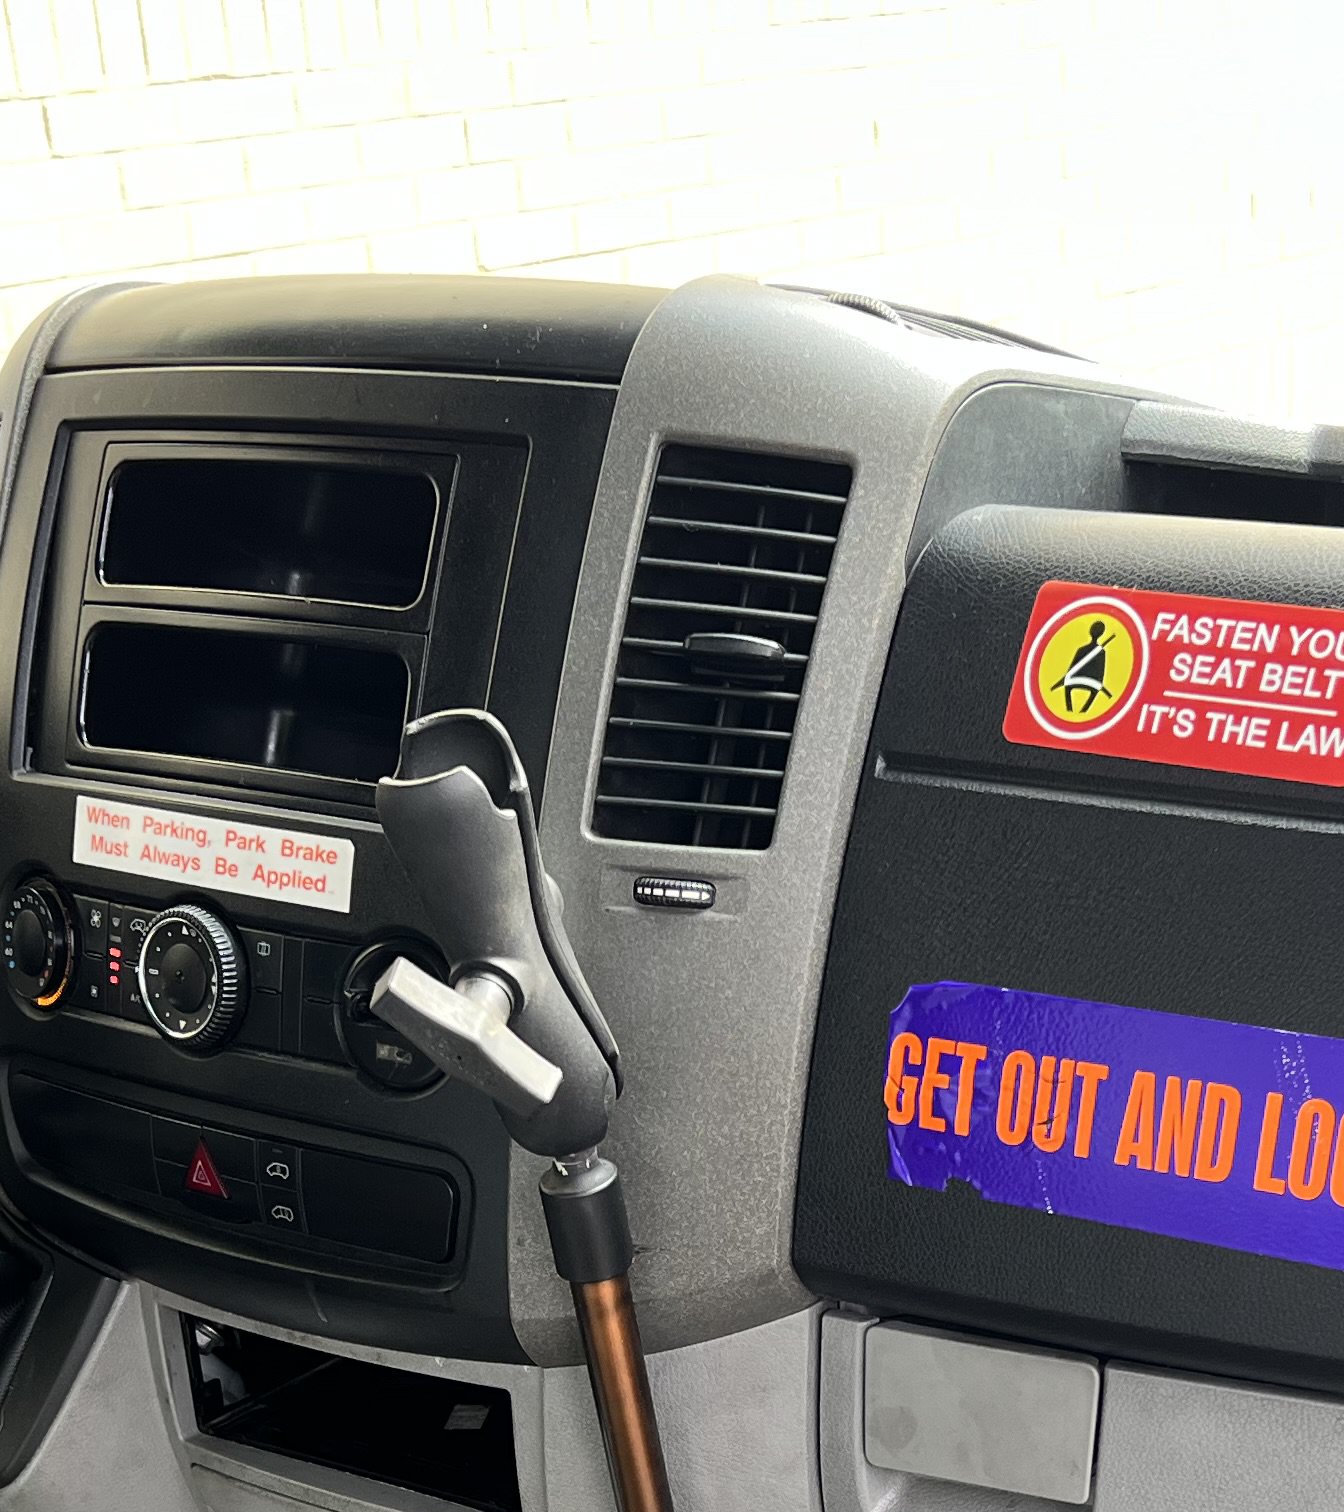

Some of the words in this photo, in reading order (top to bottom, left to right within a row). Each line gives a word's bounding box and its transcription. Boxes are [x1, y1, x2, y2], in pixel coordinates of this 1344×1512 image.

[1151, 612, 1280, 653] FASTEN
[1169, 653, 1255, 689] SEAT
[1137, 704, 1196, 738] IT'S
[1206, 711, 1271, 748] THE
[86, 805, 130, 830] When
[143, 816, 212, 848] Parking,
[224, 829, 266, 853] Park
[281, 839, 338, 865] Brake
[91, 834, 129, 858] Must
[140, 844, 201, 874] Always
[215, 857, 239, 878] Be
[883, 1031, 987, 1138] GET
[996, 1049, 1109, 1158] OUT
[1114, 1069, 1243, 1183] AND
